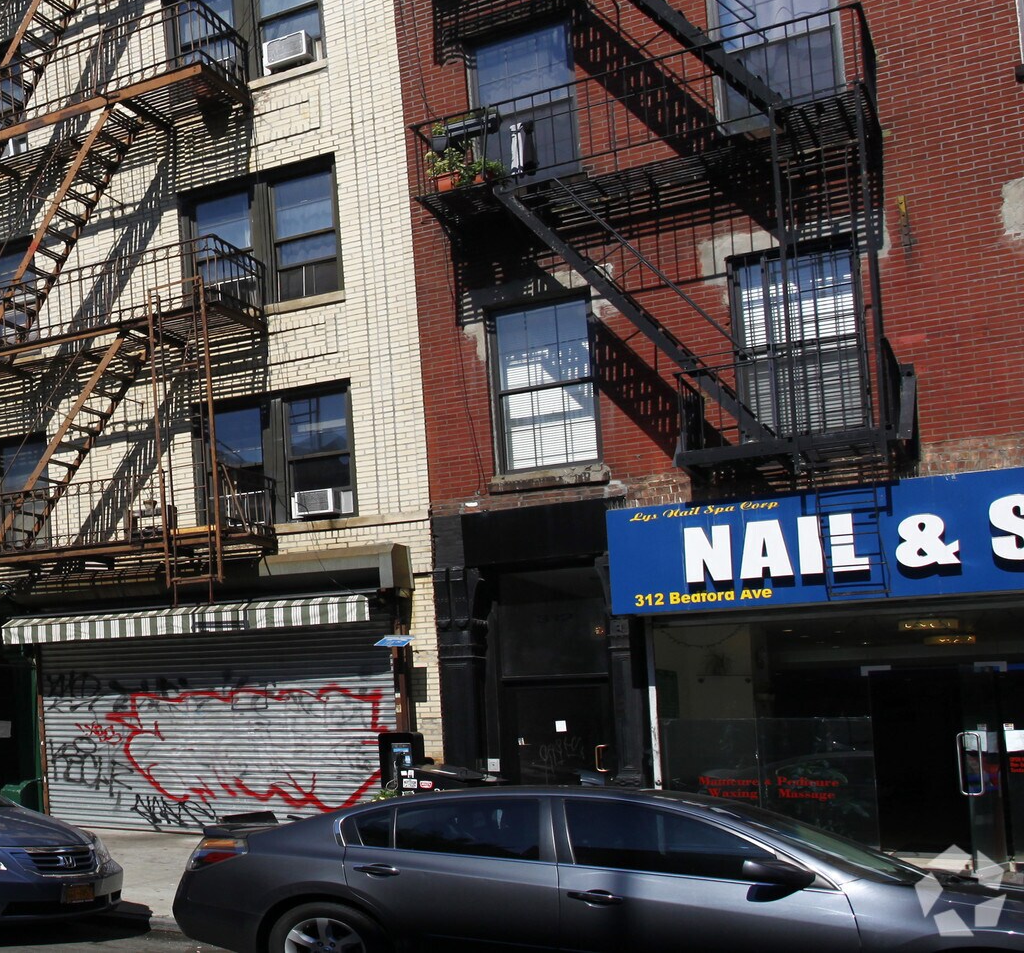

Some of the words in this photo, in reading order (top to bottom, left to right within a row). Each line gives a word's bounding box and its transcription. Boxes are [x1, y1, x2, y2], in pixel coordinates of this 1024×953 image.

[629, 512, 658, 523] Lys
[662, 506, 701, 519] Nail
[703, 504, 736, 516] Spa
[739, 500, 780, 511] Corp
[683, 512, 872, 584] NAIL
[895, 512, 962, 569] &
[634, 593, 665, 607] 312
[669, 589, 735, 605] Bedford
[740, 587, 774, 601] Ave
[698, 776, 760, 787] Manicure
[777, 776, 840, 788] Pedicure
[708, 787, 759, 800] Waxing
[778, 788, 835, 801] Massage
